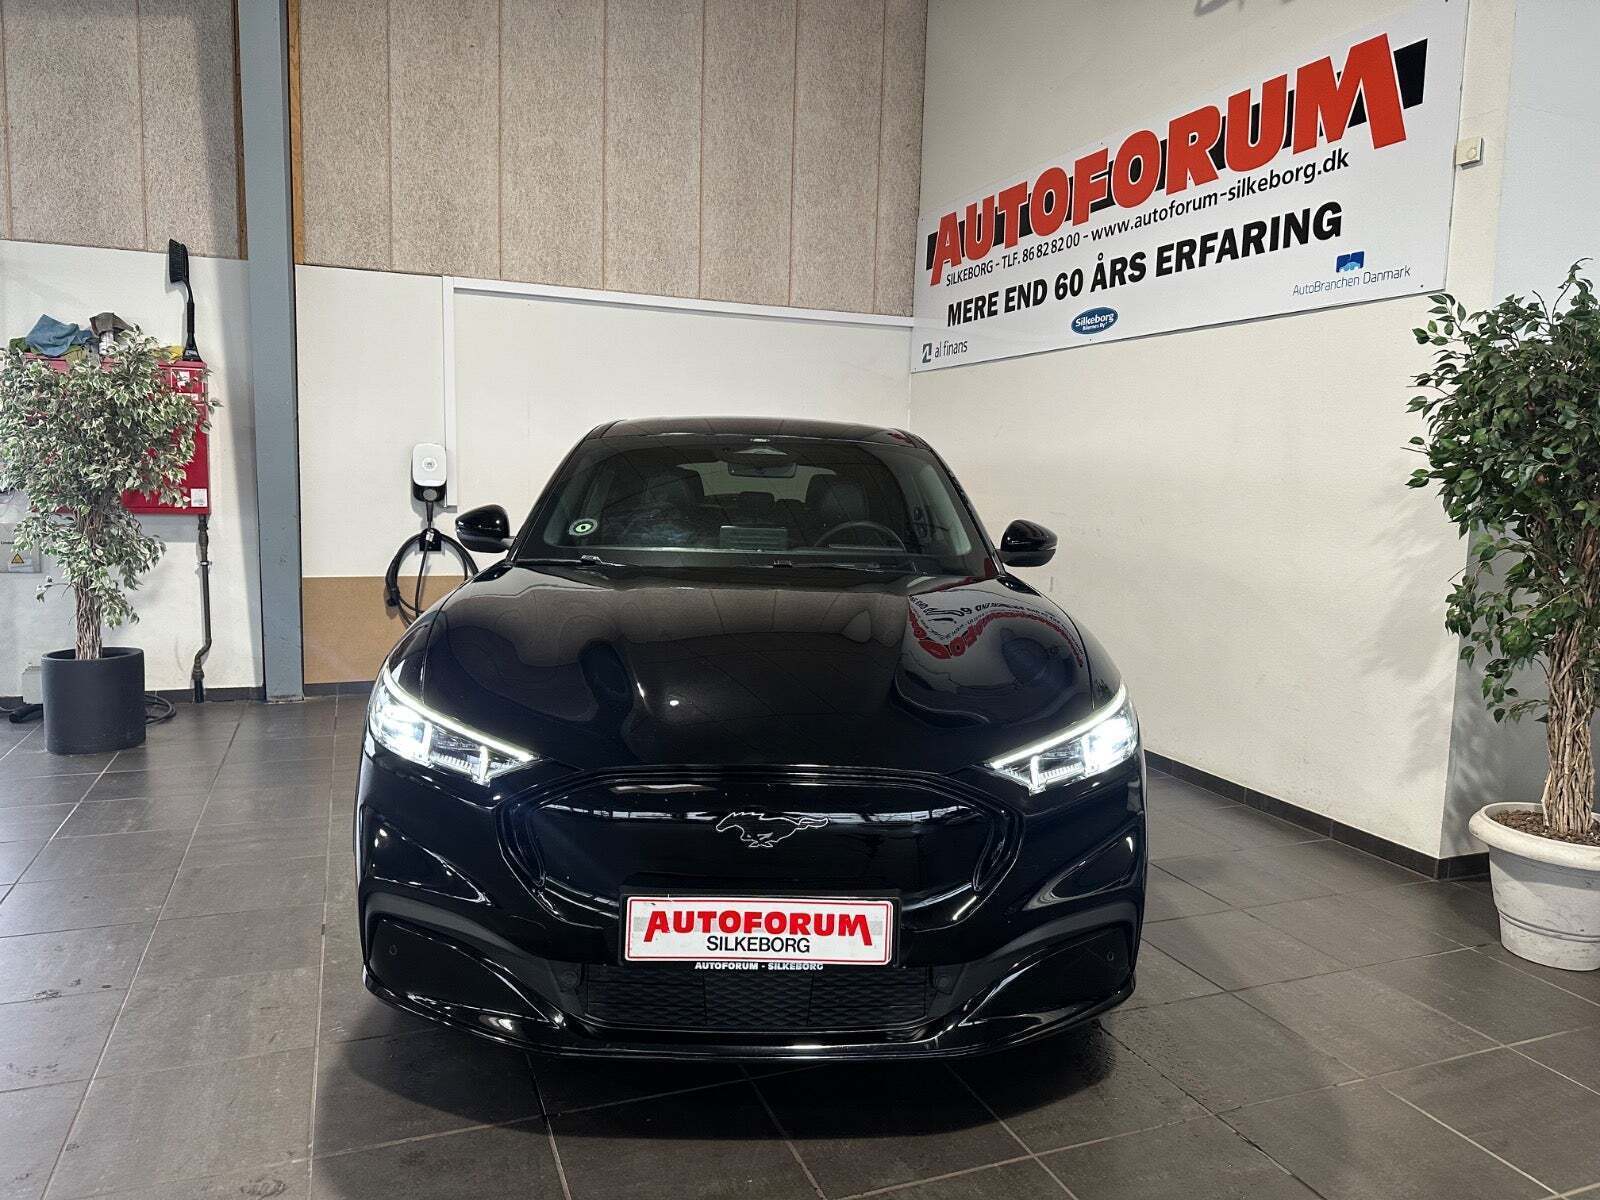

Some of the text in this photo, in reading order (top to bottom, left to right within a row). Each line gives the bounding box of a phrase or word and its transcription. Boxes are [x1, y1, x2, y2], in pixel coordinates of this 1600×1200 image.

[929, 33, 1407, 286] AUTOFORUM
[946, 260, 993, 287] SILKEBORG
[1002, 251, 1021, 269] TLF.
[947, 201, 1343, 327] MERE END 60 ÅRS ERFARING
[1292, 265, 1411, 296] AutoBranchen Danmark
[1075, 313, 1115, 328] Silkeborg
[943, 340, 968, 356] finans
[643, 910, 873, 947] AUTOFORUM
[706, 935, 811, 954] SILKEBORG
[694, 961, 759, 970] AUTOFORUM
[768, 962, 824, 971] SILKEBORG
